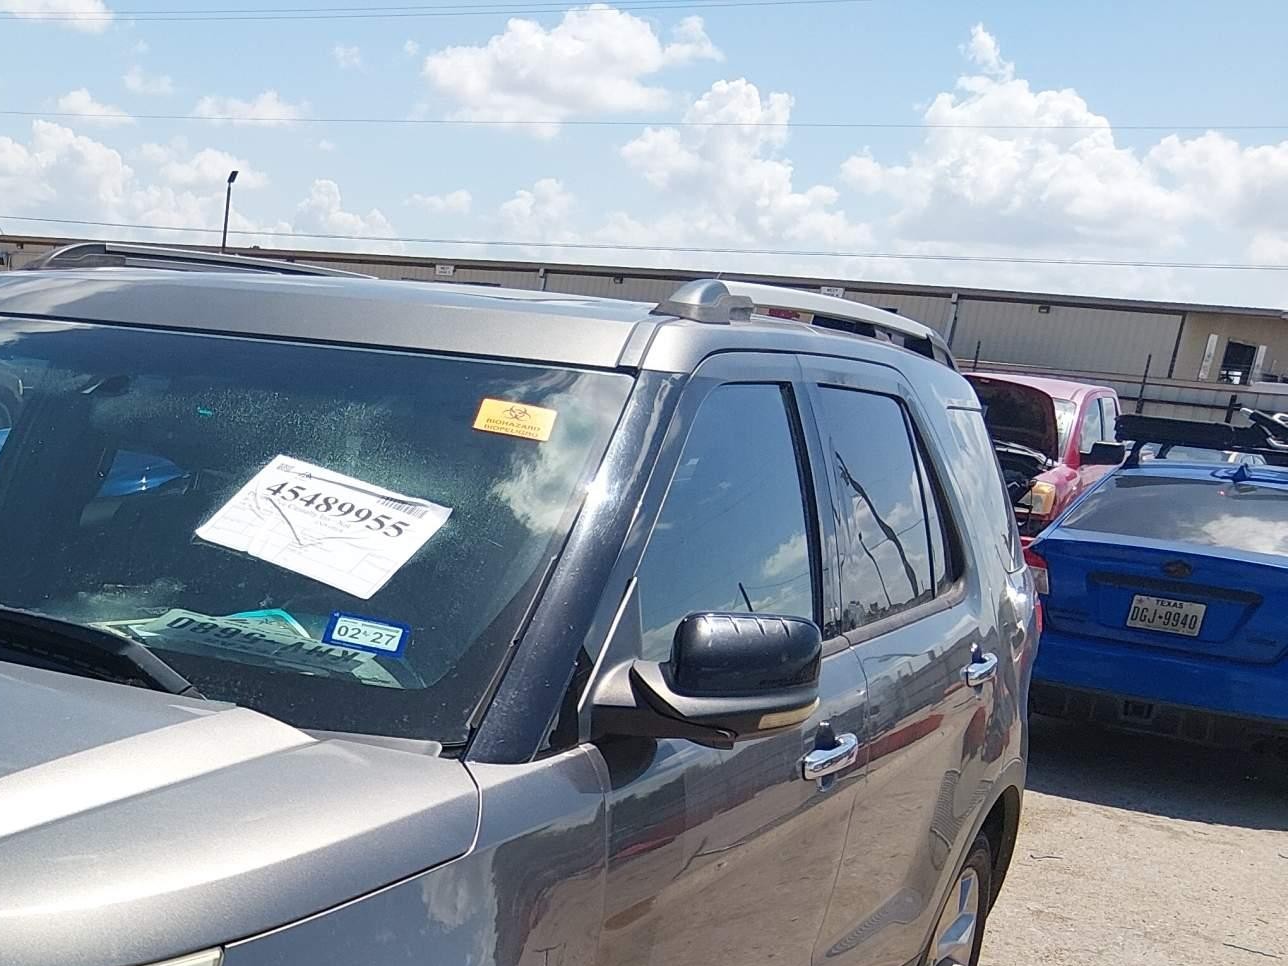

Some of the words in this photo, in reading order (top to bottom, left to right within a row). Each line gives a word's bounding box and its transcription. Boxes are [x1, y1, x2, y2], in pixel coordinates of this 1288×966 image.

[486, 418, 541, 431] BIOHAZARD
[266, 481, 411, 538] 45489955
[1155, 599, 1184, 609] TEXAS
[337, 625, 362, 640] 02
[369, 631, 397, 646] 27
